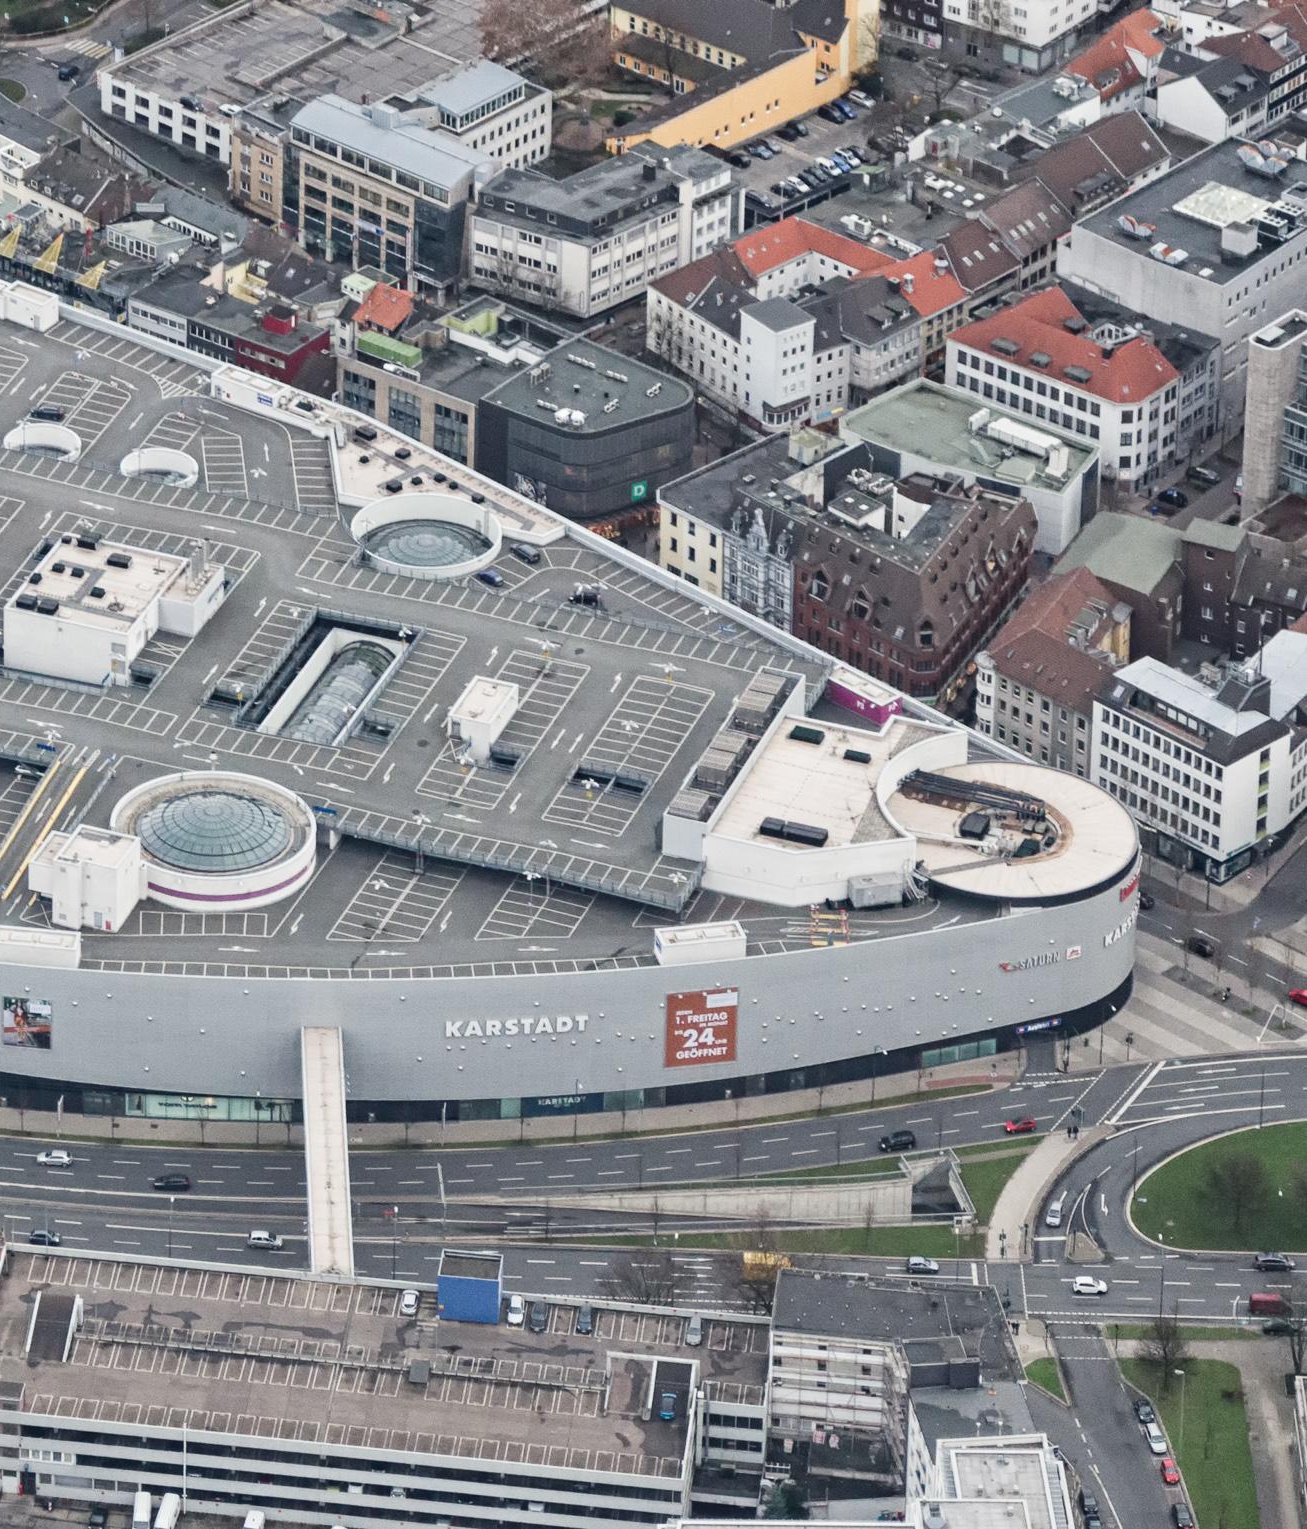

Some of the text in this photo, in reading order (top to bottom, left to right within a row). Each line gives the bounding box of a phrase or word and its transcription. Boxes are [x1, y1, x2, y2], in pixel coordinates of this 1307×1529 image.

[1019, 952, 1060, 970] SATURN
[445, 1015, 589, 1037] KARSTADT
[676, 1012, 727, 1025] 1. FREITAG
[683, 1027, 715, 1048] 24
[676, 1047, 728, 1059] GEÖFFNET
